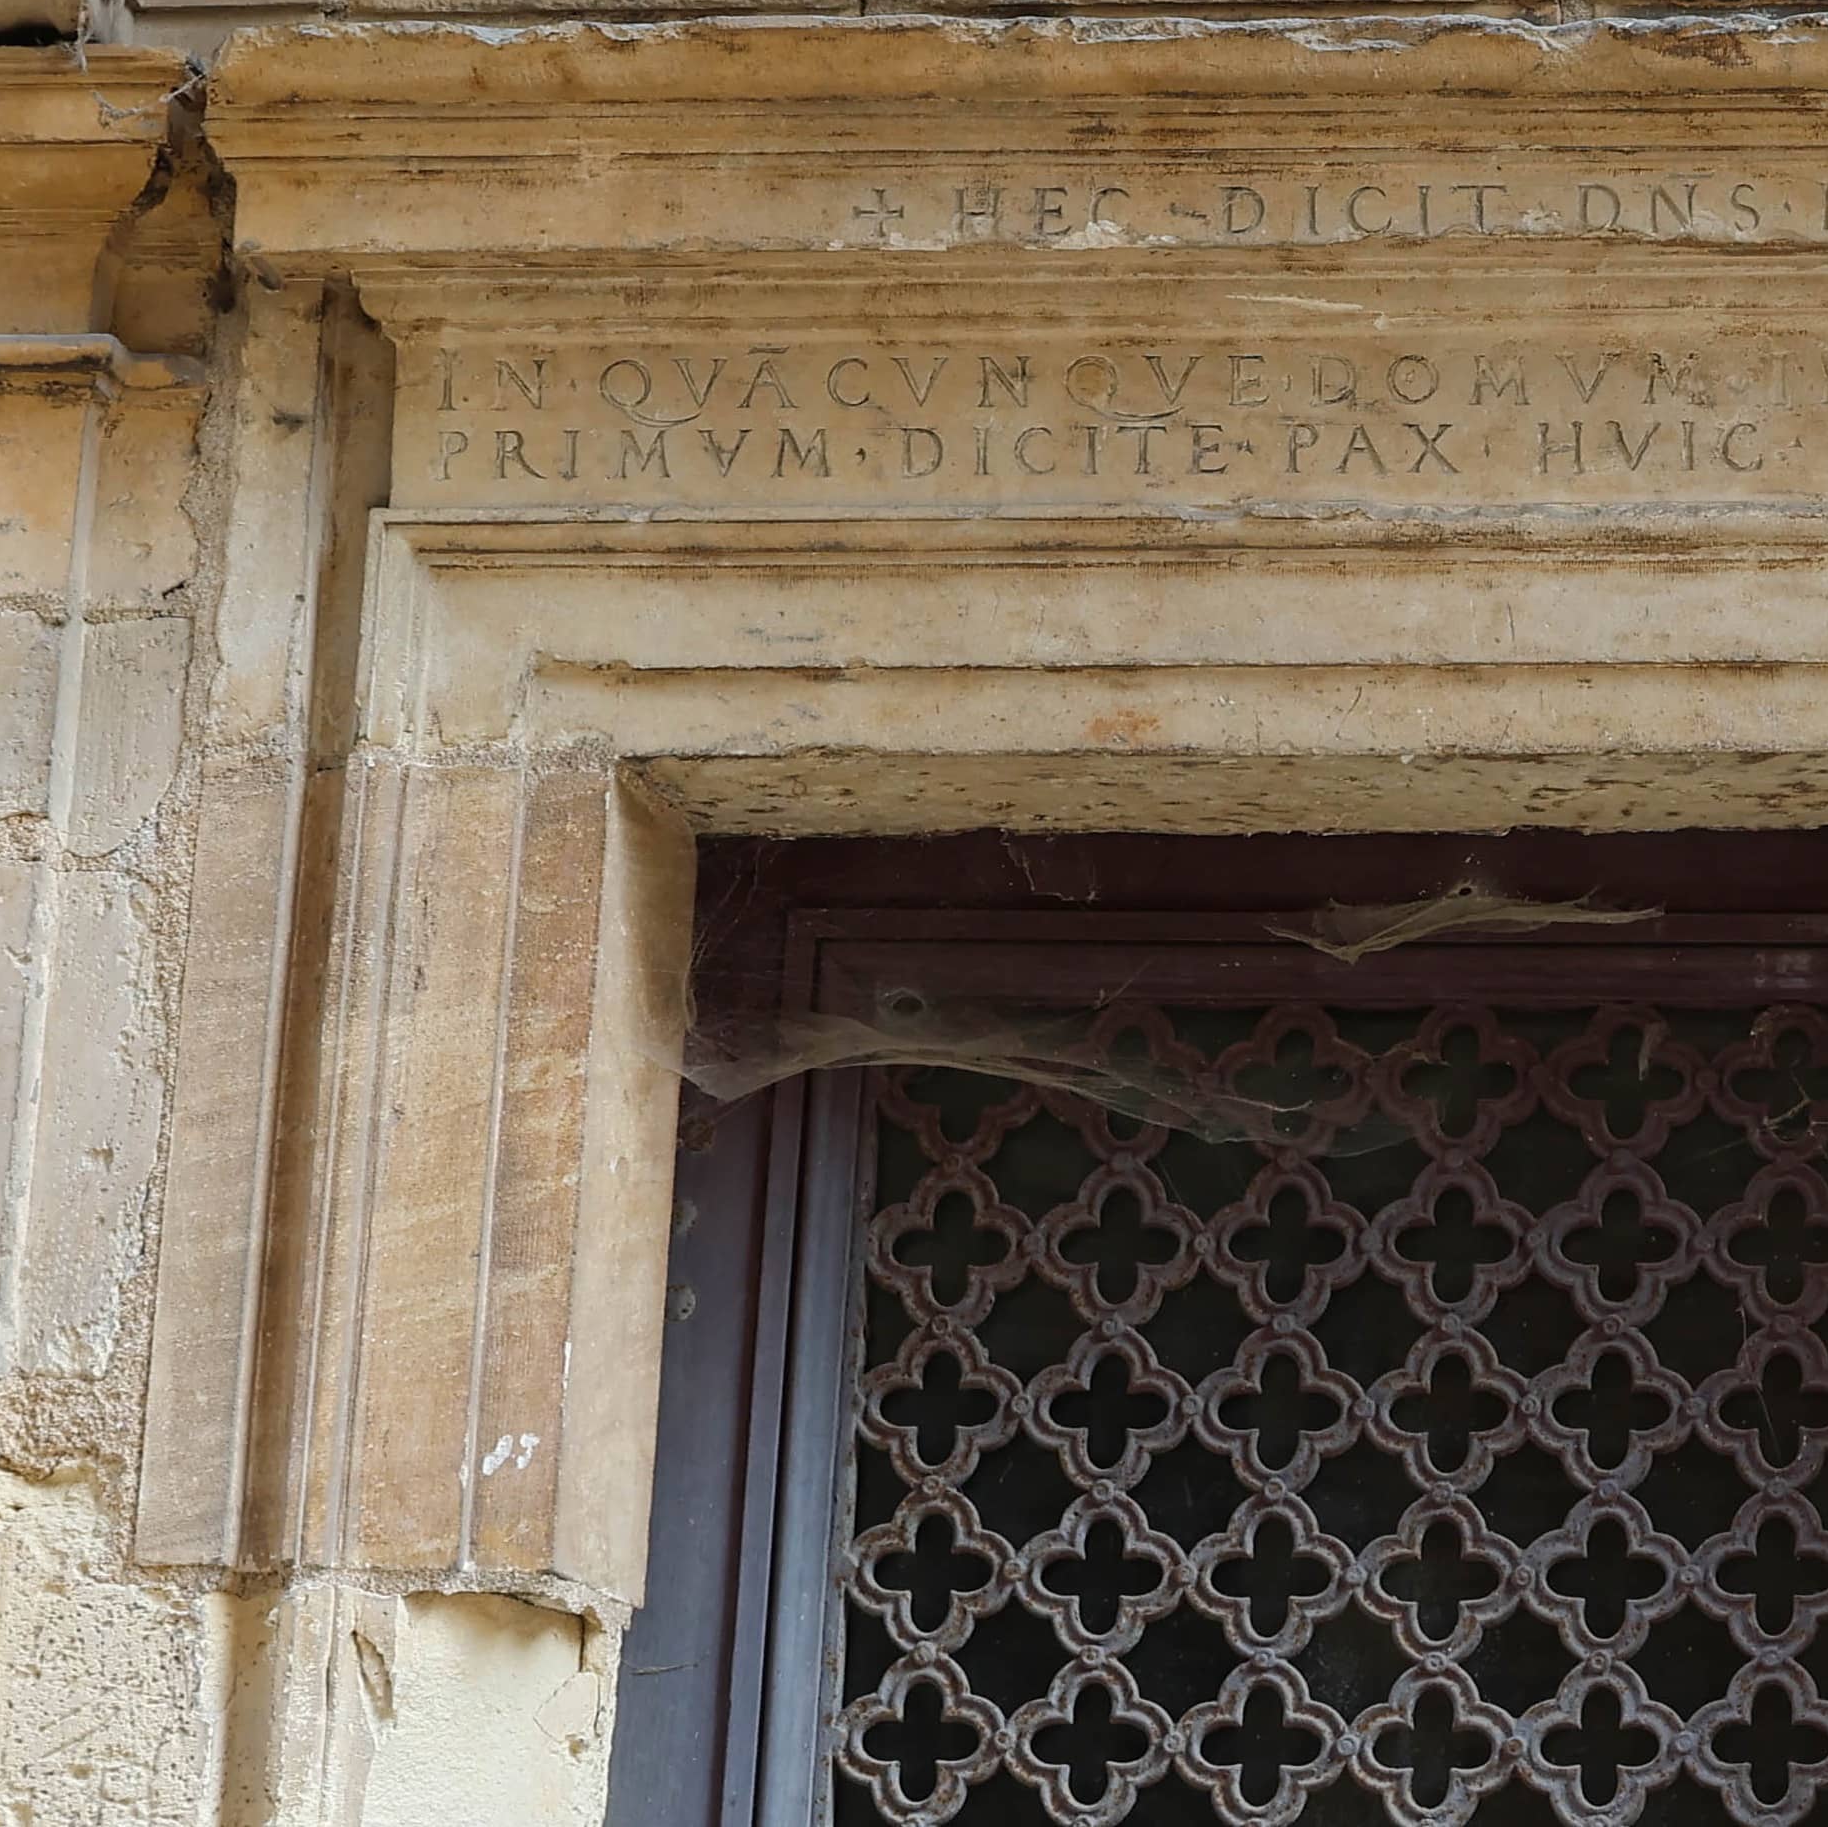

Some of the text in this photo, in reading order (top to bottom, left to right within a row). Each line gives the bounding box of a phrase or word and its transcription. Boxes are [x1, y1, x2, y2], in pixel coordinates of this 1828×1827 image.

[1218, 183, 1509, 236] DICIT
[433, 426, 834, 481] PRIMVM
[889, 422, 1231, 478] DICITE
[1283, 422, 1461, 475] PAX
[1536, 419, 1763, 474] HVIC
